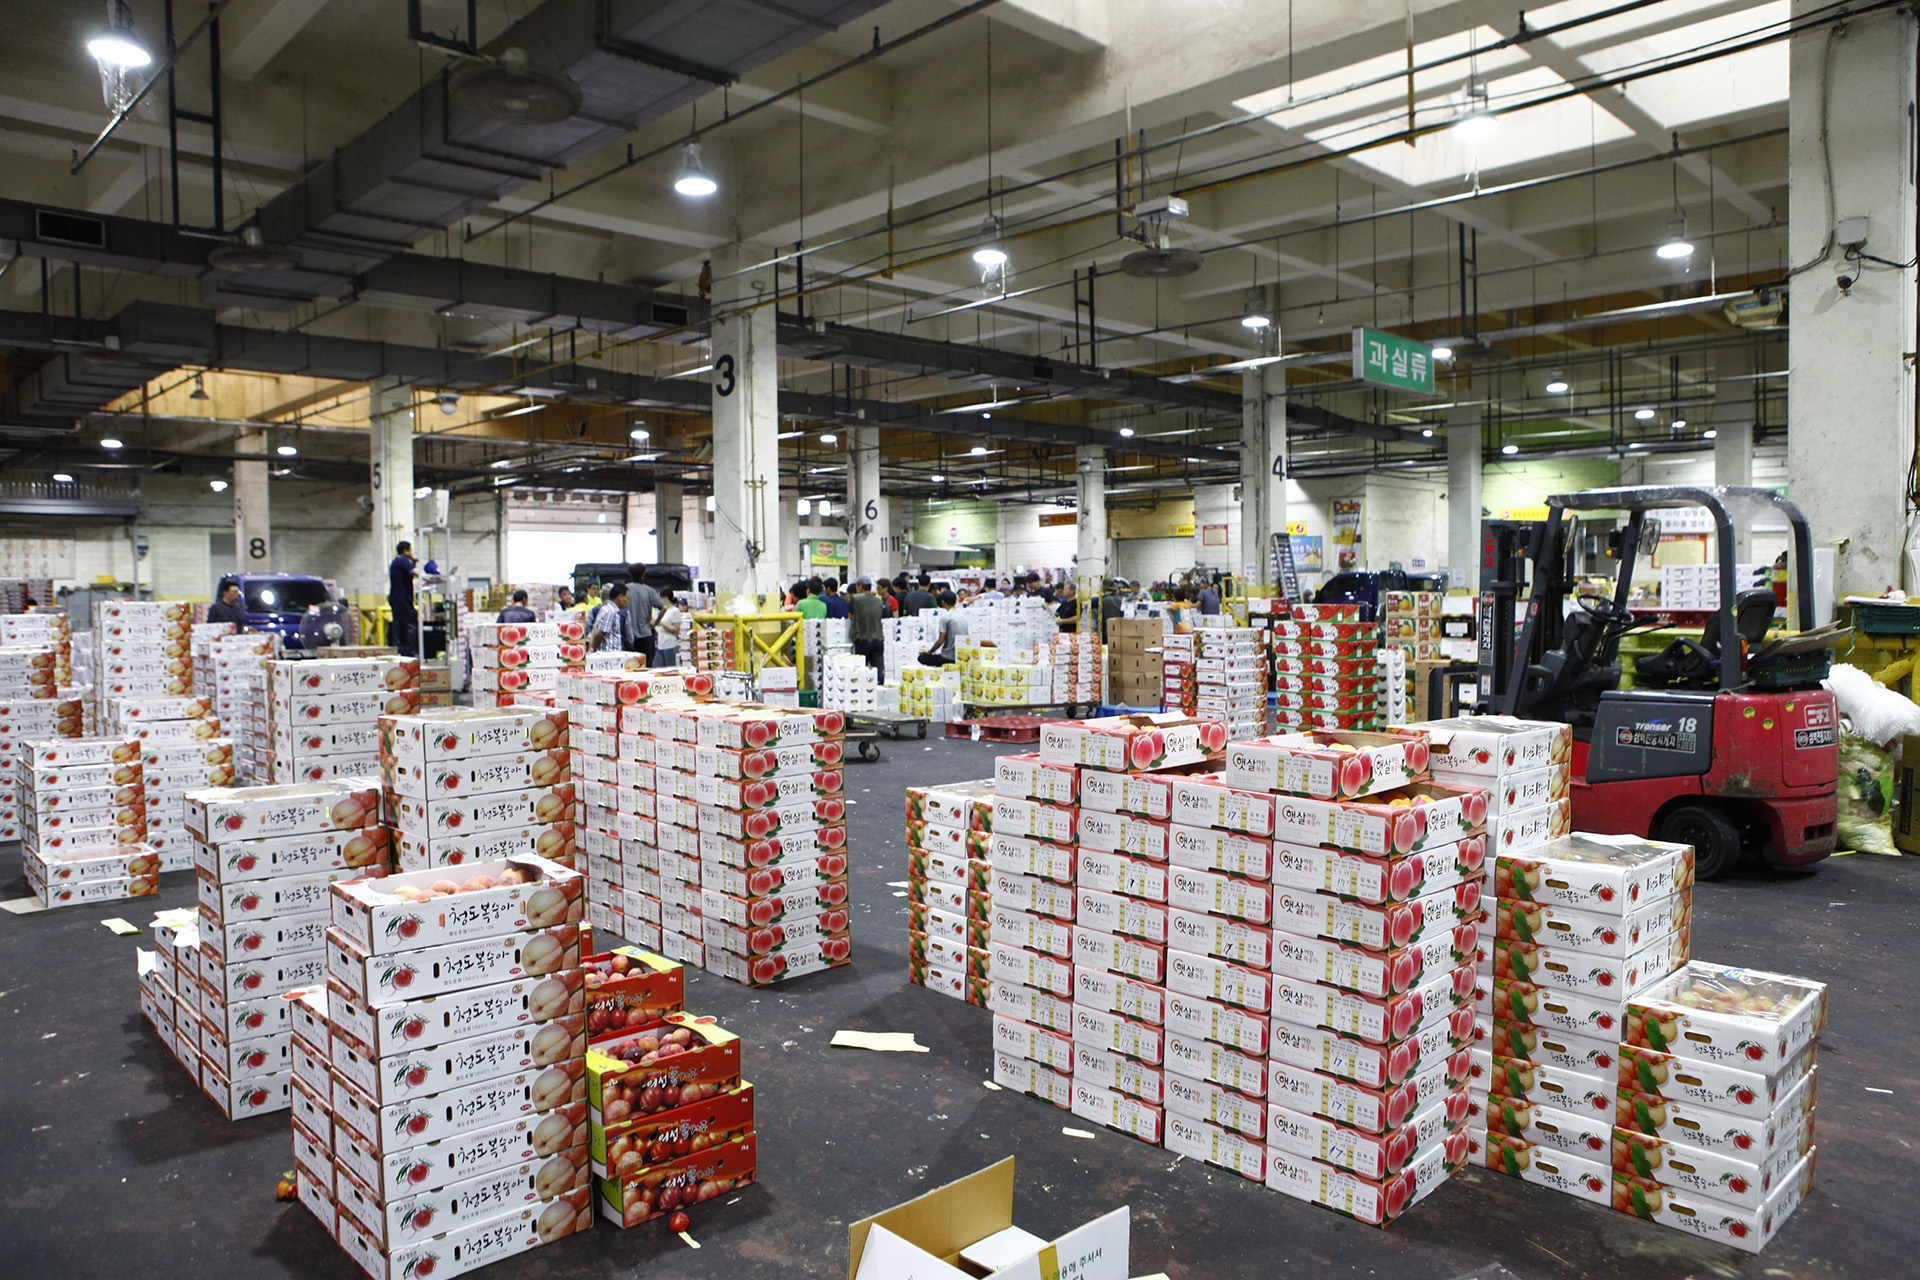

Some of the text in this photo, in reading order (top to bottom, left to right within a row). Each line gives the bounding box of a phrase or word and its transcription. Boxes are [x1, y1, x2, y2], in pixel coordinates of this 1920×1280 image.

[1369, 341, 1427, 382] 과실류
[715, 354, 735, 397] 3
[373, 462, 382, 489] 5
[1272, 455, 1285, 481] 4
[865, 499, 878, 520] 6
[1333, 500, 1361, 513] Dole
[668, 517, 681, 534] 7
[250, 538, 267, 559] 8
[1635, 717, 1697, 732] Transer 18
[476, 728, 520, 745] 청도복숭아
[1048, 737, 1066, 749] 햇살
[1237, 757, 1255, 771] 햇살
[477, 766, 522, 783] 청도복숭아
[1089, 781, 1105, 793] 햇살
[1182, 795, 1199, 808] 햇살
[267, 808, 319, 824] 청도복숭아
[480, 803, 526, 820] 청도복숭아
[1227, 811, 1237, 820] 17
[1286, 810, 1306, 825] 햇살
[1086, 821, 1103, 834] 햇살
[482, 841, 526, 858] 청도복숭아
[1179, 836, 1196, 850] 햇살
[279, 846, 331, 864] 청도복숭아
[1284, 855, 1303, 870] 햇살
[1086, 861, 1102, 874] 햇살
[1178, 879, 1195, 893] 햇살
[449, 902, 514, 925] 청도복숭아
[1086, 900, 1101, 913] 햇살
[1284, 899, 1304, 915] 햇살
[1178, 921, 1195, 936] 햇살
[1080, 936, 1096, 952] 햇살
[1283, 945, 1303, 960] 햇살
[444, 952, 509, 975] 청도복숭아
[1175, 961, 1194, 978] 햇살
[1082, 976, 1098, 992] 햇살
[1283, 989, 1303, 1005] 햇살
[454, 999, 517, 1023] 청도복숭아
[1172, 1004, 1191, 1019] 햇살
[1080, 1017, 1096, 1030] 햇살
[1281, 1030, 1300, 1048] 햇살
[455, 1043, 519, 1068] 청도복숭아
[1173, 1042, 1191, 1059] 햇살
[1081, 1054, 1098, 1068] 햇살
[1172, 1083, 1191, 1100] 햇살
[1279, 1076, 1299, 1092] 햇살
[456, 1090, 520, 1115] 청도복숭아
[1080, 1089, 1098, 1106] 햇살
[1174, 1123, 1192, 1140] 햇살
[1279, 1119, 1298, 1136] 햇살
[458, 1136, 521, 1163] 청도복숭아
[1276, 1162, 1297, 1179] 햇살
[462, 1180, 524, 1208] 청도복숭아
[464, 1223, 526, 1254] 청도복숭아
